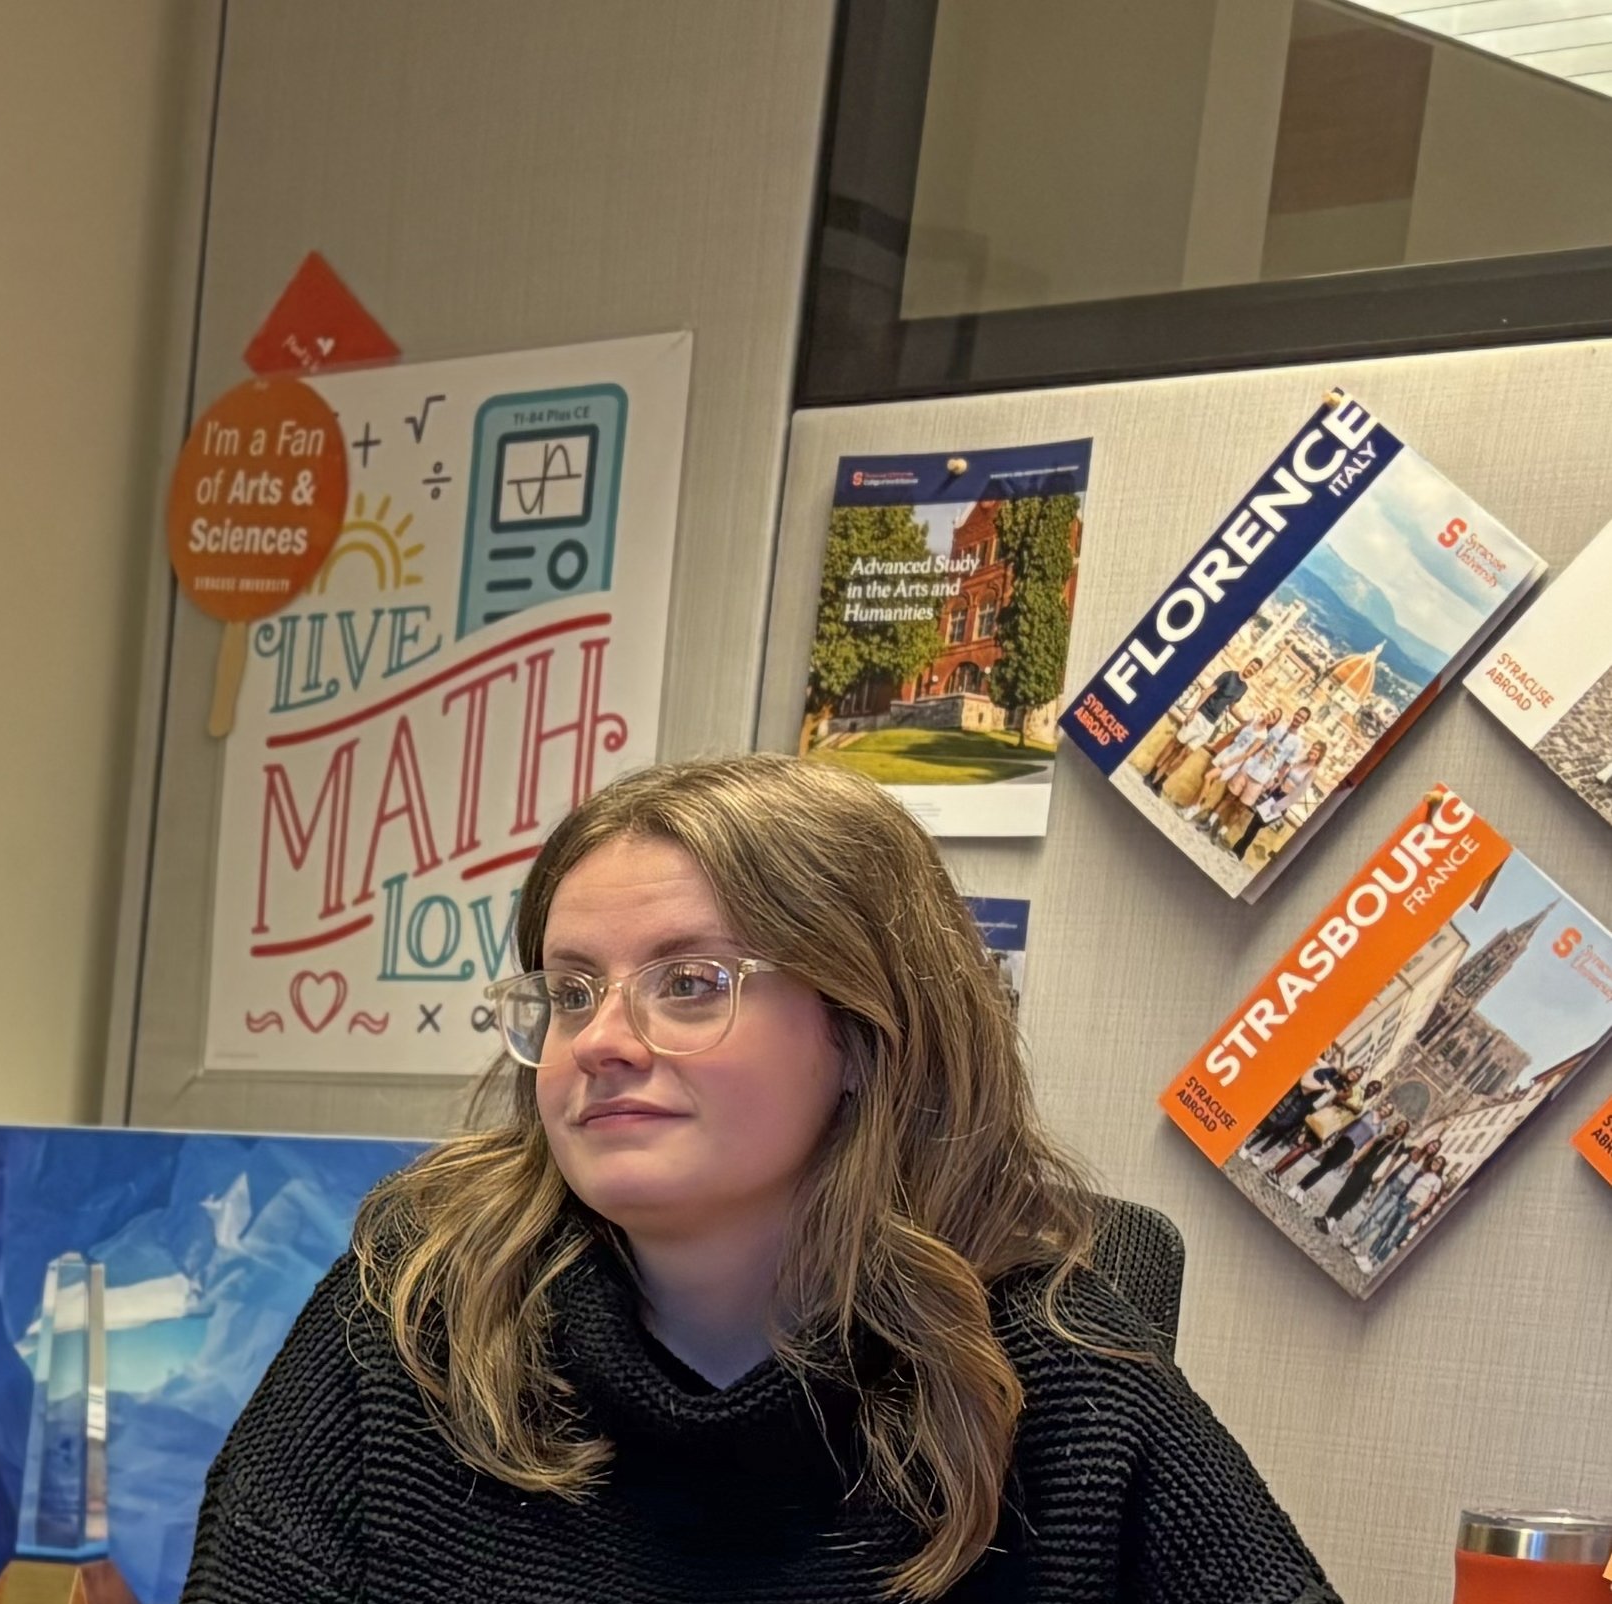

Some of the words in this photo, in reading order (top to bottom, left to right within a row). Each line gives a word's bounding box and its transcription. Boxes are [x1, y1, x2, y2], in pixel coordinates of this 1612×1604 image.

[513, 409, 544, 426] TI-84
[546, 407, 572, 422] Plus
[573, 404, 591, 420] CE
[203, 420, 239, 456] I'm
[249, 429, 267, 456] a
[277, 420, 325, 457] Fan
[196, 469, 224, 505] of
[227, 470, 283, 505] Arts
[291, 469, 316, 506] &
[1328, 439, 1377, 498] ITALY
[189, 517, 309, 555] Sciences
[1103, 397, 1378, 705] FLORENCE
[1465, 532, 1507, 572] Syracuse
[847, 582, 863, 598] in
[866, 580, 890, 598] the
[893, 580, 928, 598] Arts
[931, 578, 961, 597] and
[850, 556, 932, 576] Advanced
[934, 554, 981, 577] Study
[844, 603, 934, 622] Humanities
[253, 606, 442, 714] LIVE
[1496, 652, 1555, 709] SYRACUSE
[1485, 667, 1533, 712] ABROAD
[1072, 706, 1111, 748] ABROAD
[1082, 691, 1130, 745] SYRACUSE
[251, 637, 628, 934] MATH
[1402, 833, 1481, 917] FRANCE
[1205, 790, 1477, 1088] STRASBOURG
[1175, 1088, 1219, 1136] ABROAD
[1183, 1075, 1238, 1133] SYRACUSE
